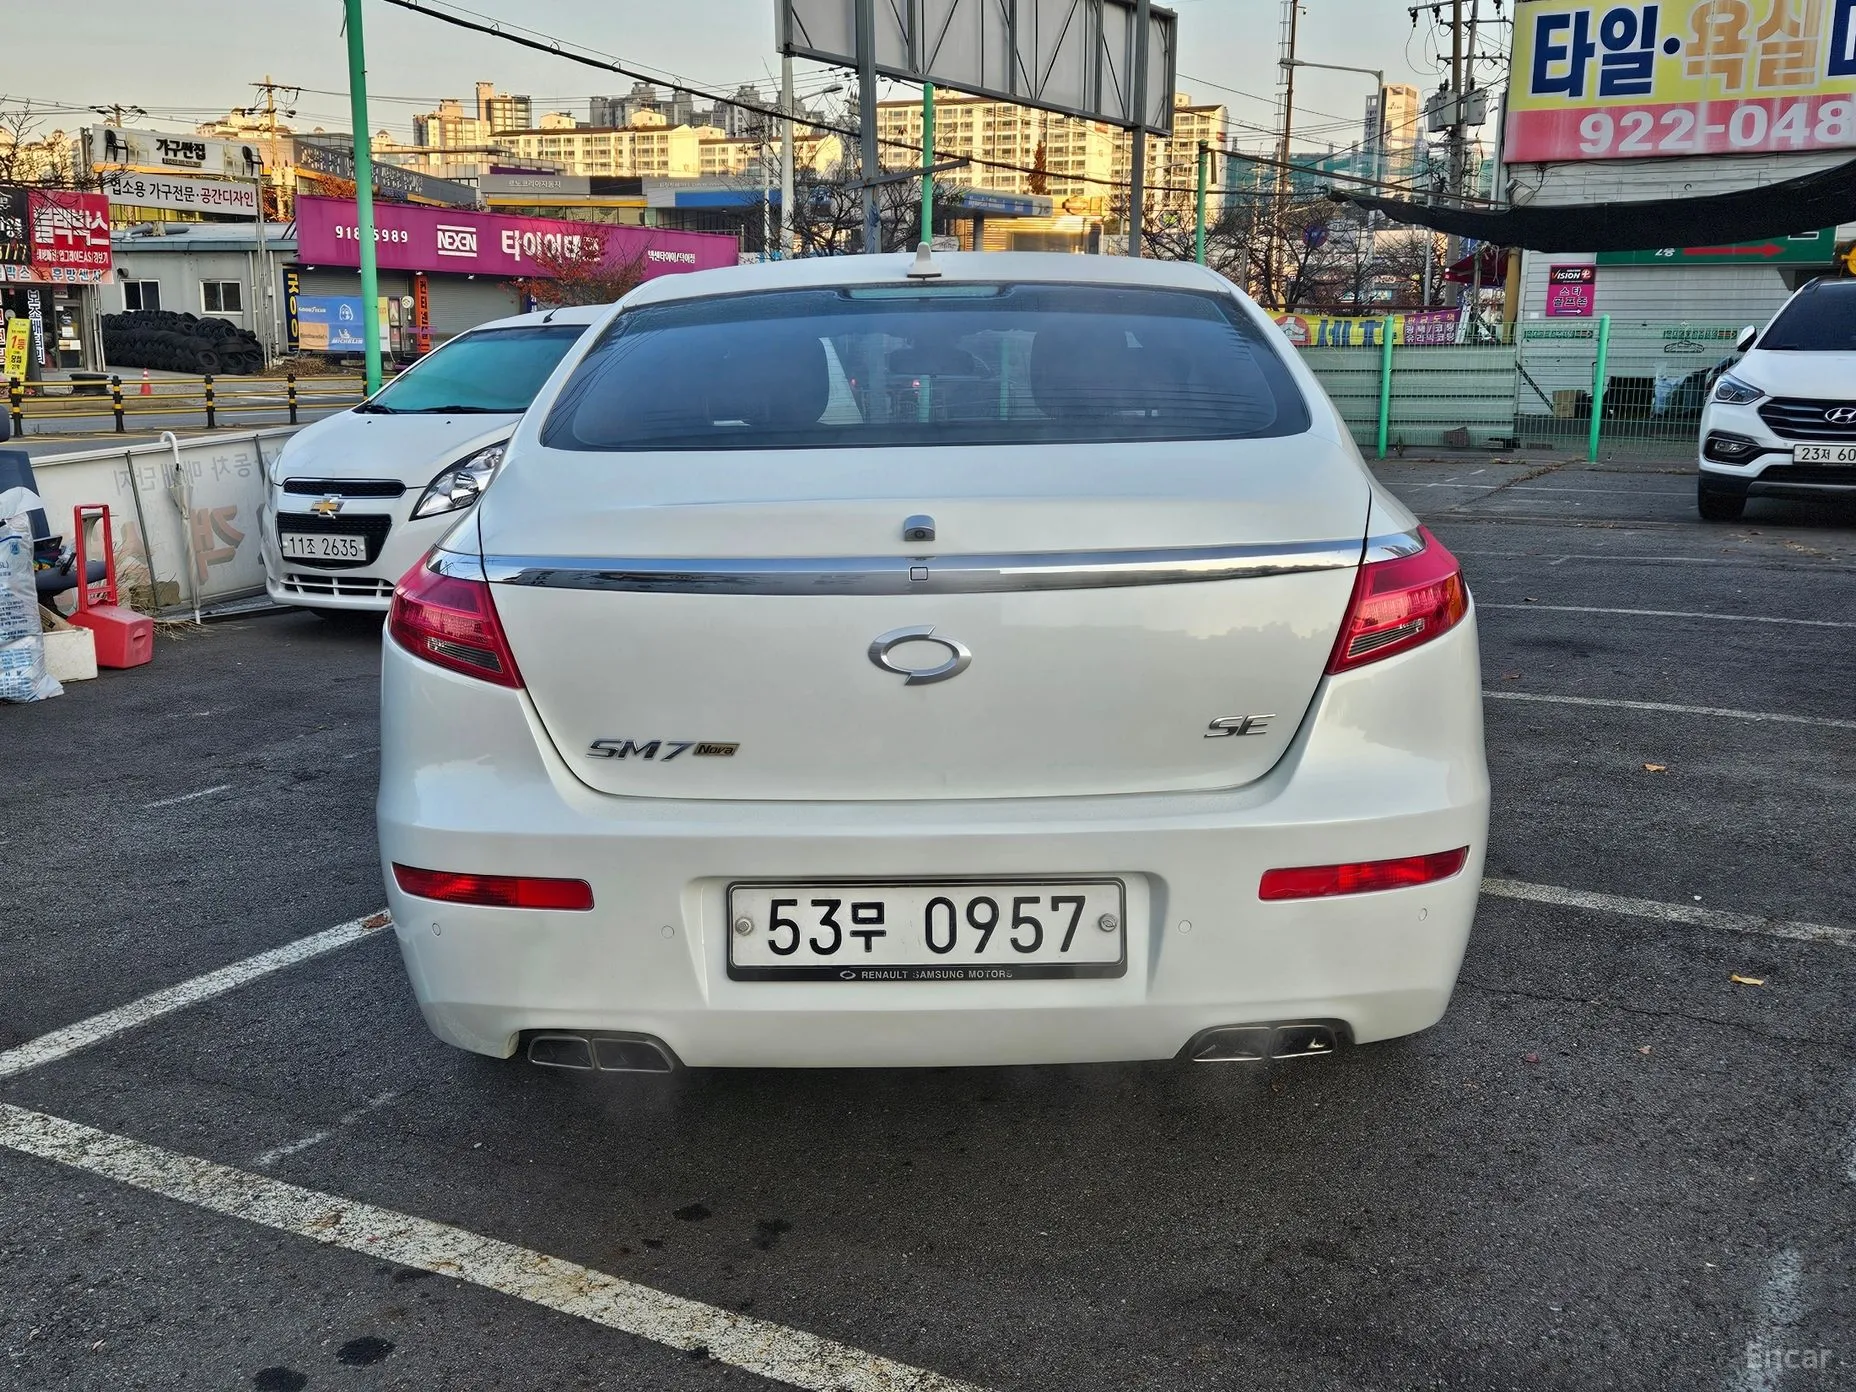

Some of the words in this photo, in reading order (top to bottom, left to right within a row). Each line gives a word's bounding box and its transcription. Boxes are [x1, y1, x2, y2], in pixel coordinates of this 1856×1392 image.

[150, 183, 254, 207] 가구전문·공간디자인
[34, 207, 109, 246] 블랙박스
[335, 225, 409, 243] 9185989
[437, 230, 477, 251] NEXEN
[1551, 270, 1581, 279] VISION
[1801, 447, 1831, 461] 23저
[289, 536, 316, 554] 11조
[321, 537, 358, 557] 2635
[1204, 713, 1276, 739] SE
[586, 738, 697, 761] SM7
[697, 743, 735, 756] Nova
[767, 898, 887, 956] 53무
[924, 895, 1086, 954] 0957
[861, 970, 908, 980] RENAULT
[912, 970, 964, 979] SAMSUNG
[968, 969, 1013, 979] MOTORS
